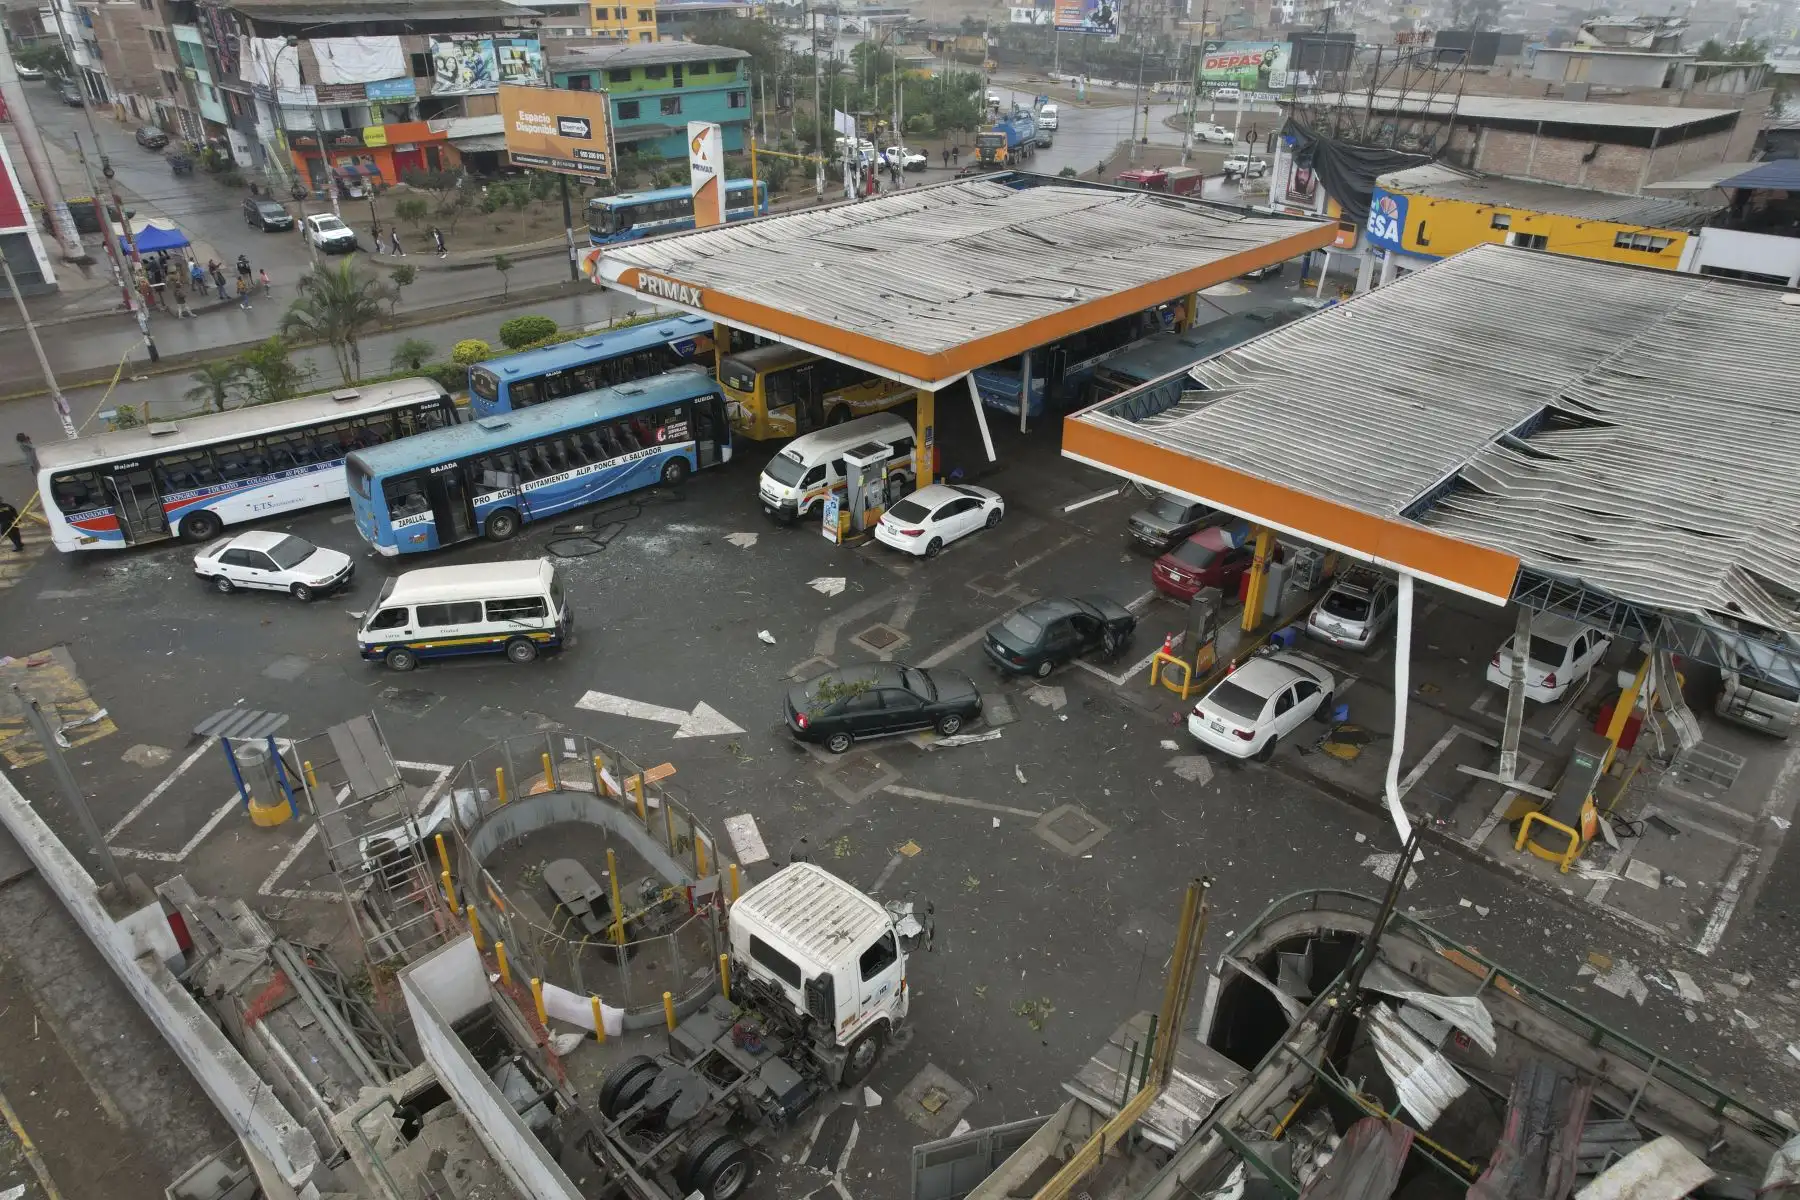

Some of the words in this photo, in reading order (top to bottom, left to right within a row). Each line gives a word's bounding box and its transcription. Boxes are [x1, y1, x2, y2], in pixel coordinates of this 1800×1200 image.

[1205, 53, 1263, 70] DEPAS
[519, 110, 551, 123] Espacio
[516, 121, 558, 136] Disponible
[638, 272, 702, 308] PRIMAX
[694, 395, 715, 404] SUBIDA
[113, 461, 139, 471] Bajada
[430, 462, 458, 474] BAJADA
[220, 481, 239, 491] MAYO
[246, 474, 277, 486] COLONIAL
[473, 495, 491, 506] PRO
[525, 472, 569, 491] EVITAMIENTO
[576, 467, 592, 477] ALIP.
[594, 459, 616, 471] PONCE
[622, 455, 629, 463] V.
[629, 446, 662, 461] SALVADOR
[398, 515, 426, 528] ZAPALLAL
